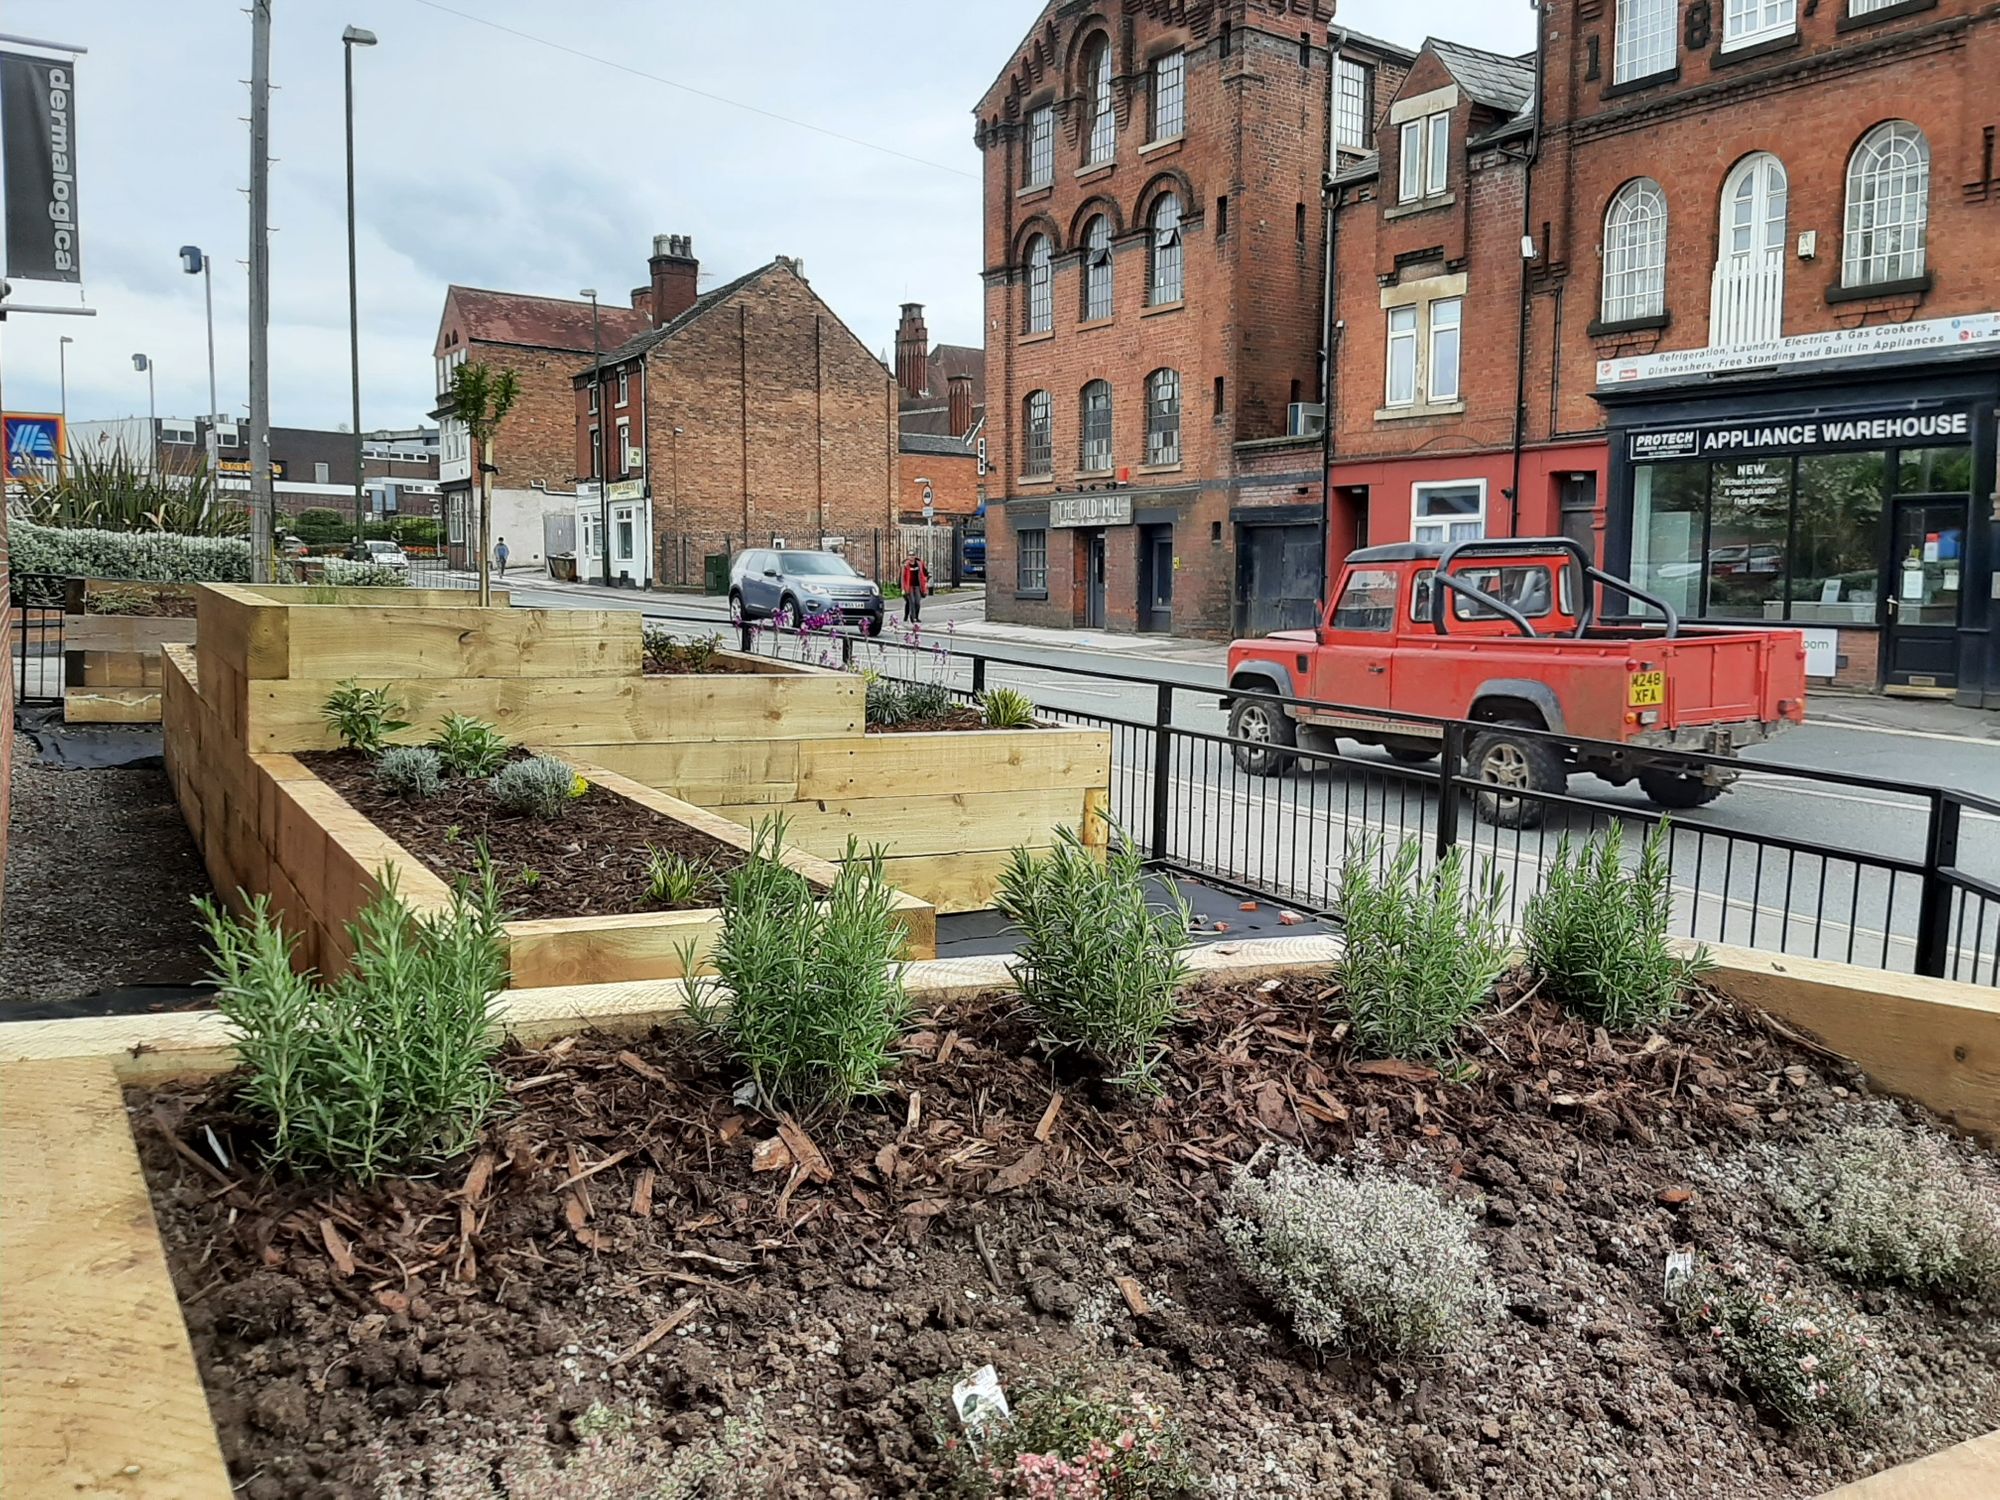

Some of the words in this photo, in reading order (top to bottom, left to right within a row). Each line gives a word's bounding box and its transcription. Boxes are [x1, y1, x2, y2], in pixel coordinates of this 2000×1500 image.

[48, 67, 75, 272] dermalogica
[1658, 347, 1728, 363] Refrigeration,
[1733, 341, 1780, 354] Laundry,
[1785, 333, 1830, 347] Electric
[1834, 331, 1843, 341] &
[1848, 329, 1871, 339] Gas
[1875, 323, 1931, 337] Cookers,
[1648, 362, 1715, 376] Dishwashers,
[1719, 357, 1742, 368] Free
[1746, 352, 1796, 365] Standing
[1799, 348, 1820, 359] and
[1824, 343, 1853, 356] Built
[1857, 340, 1869, 351] In
[1873, 333, 1945, 351] Appliances
[1635, 431, 1694, 447] PROTECH
[1704, 424, 1817, 450] APPLIANCE
[1821, 413, 1968, 442] WAREHOUSE
[1737, 464, 1766, 476] NEW
[1746, 477, 1783, 485] showroom
[1731, 488, 1754, 496] design
[1755, 486, 1777, 495] studio
[1058, 500, 1076, 520] THE
[1079, 498, 1098, 518] OLD
[1102, 496, 1122, 517] MILL
[1749, 496, 1765, 505] floor
[1803, 640, 1829, 650] oom
[1634, 688, 1657, 703] XFA
